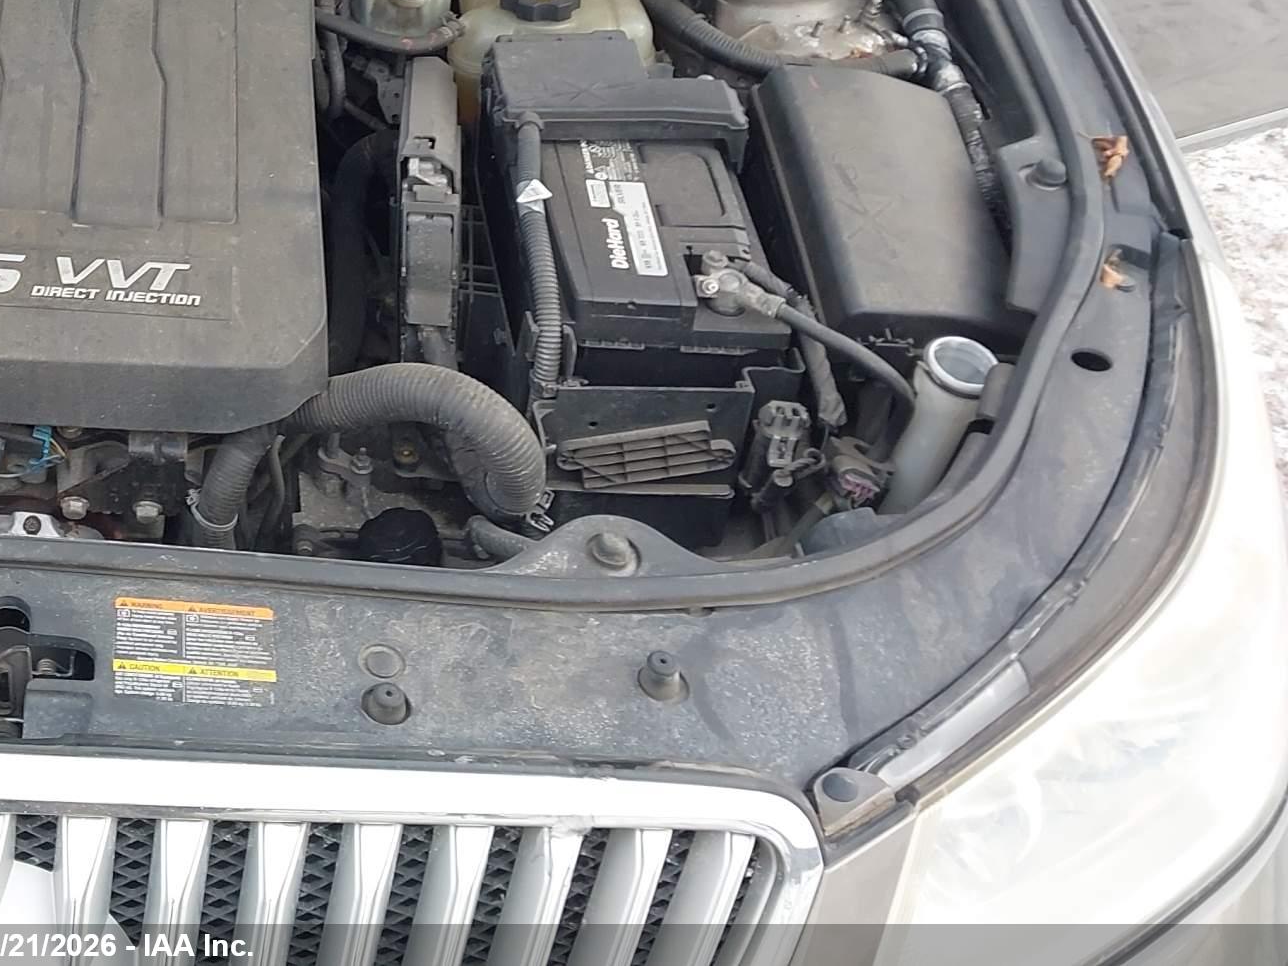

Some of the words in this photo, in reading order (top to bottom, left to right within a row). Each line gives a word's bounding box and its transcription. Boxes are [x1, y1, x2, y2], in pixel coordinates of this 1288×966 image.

[601, 218, 630, 269] DieHard
[56, 256, 192, 292] VVT
[30, 285, 101, 300] DIRECT
[105, 289, 202, 307] INJECTION
[129, 664, 161, 672] CAUTION
[200, 668, 240, 677] ATTENTION
